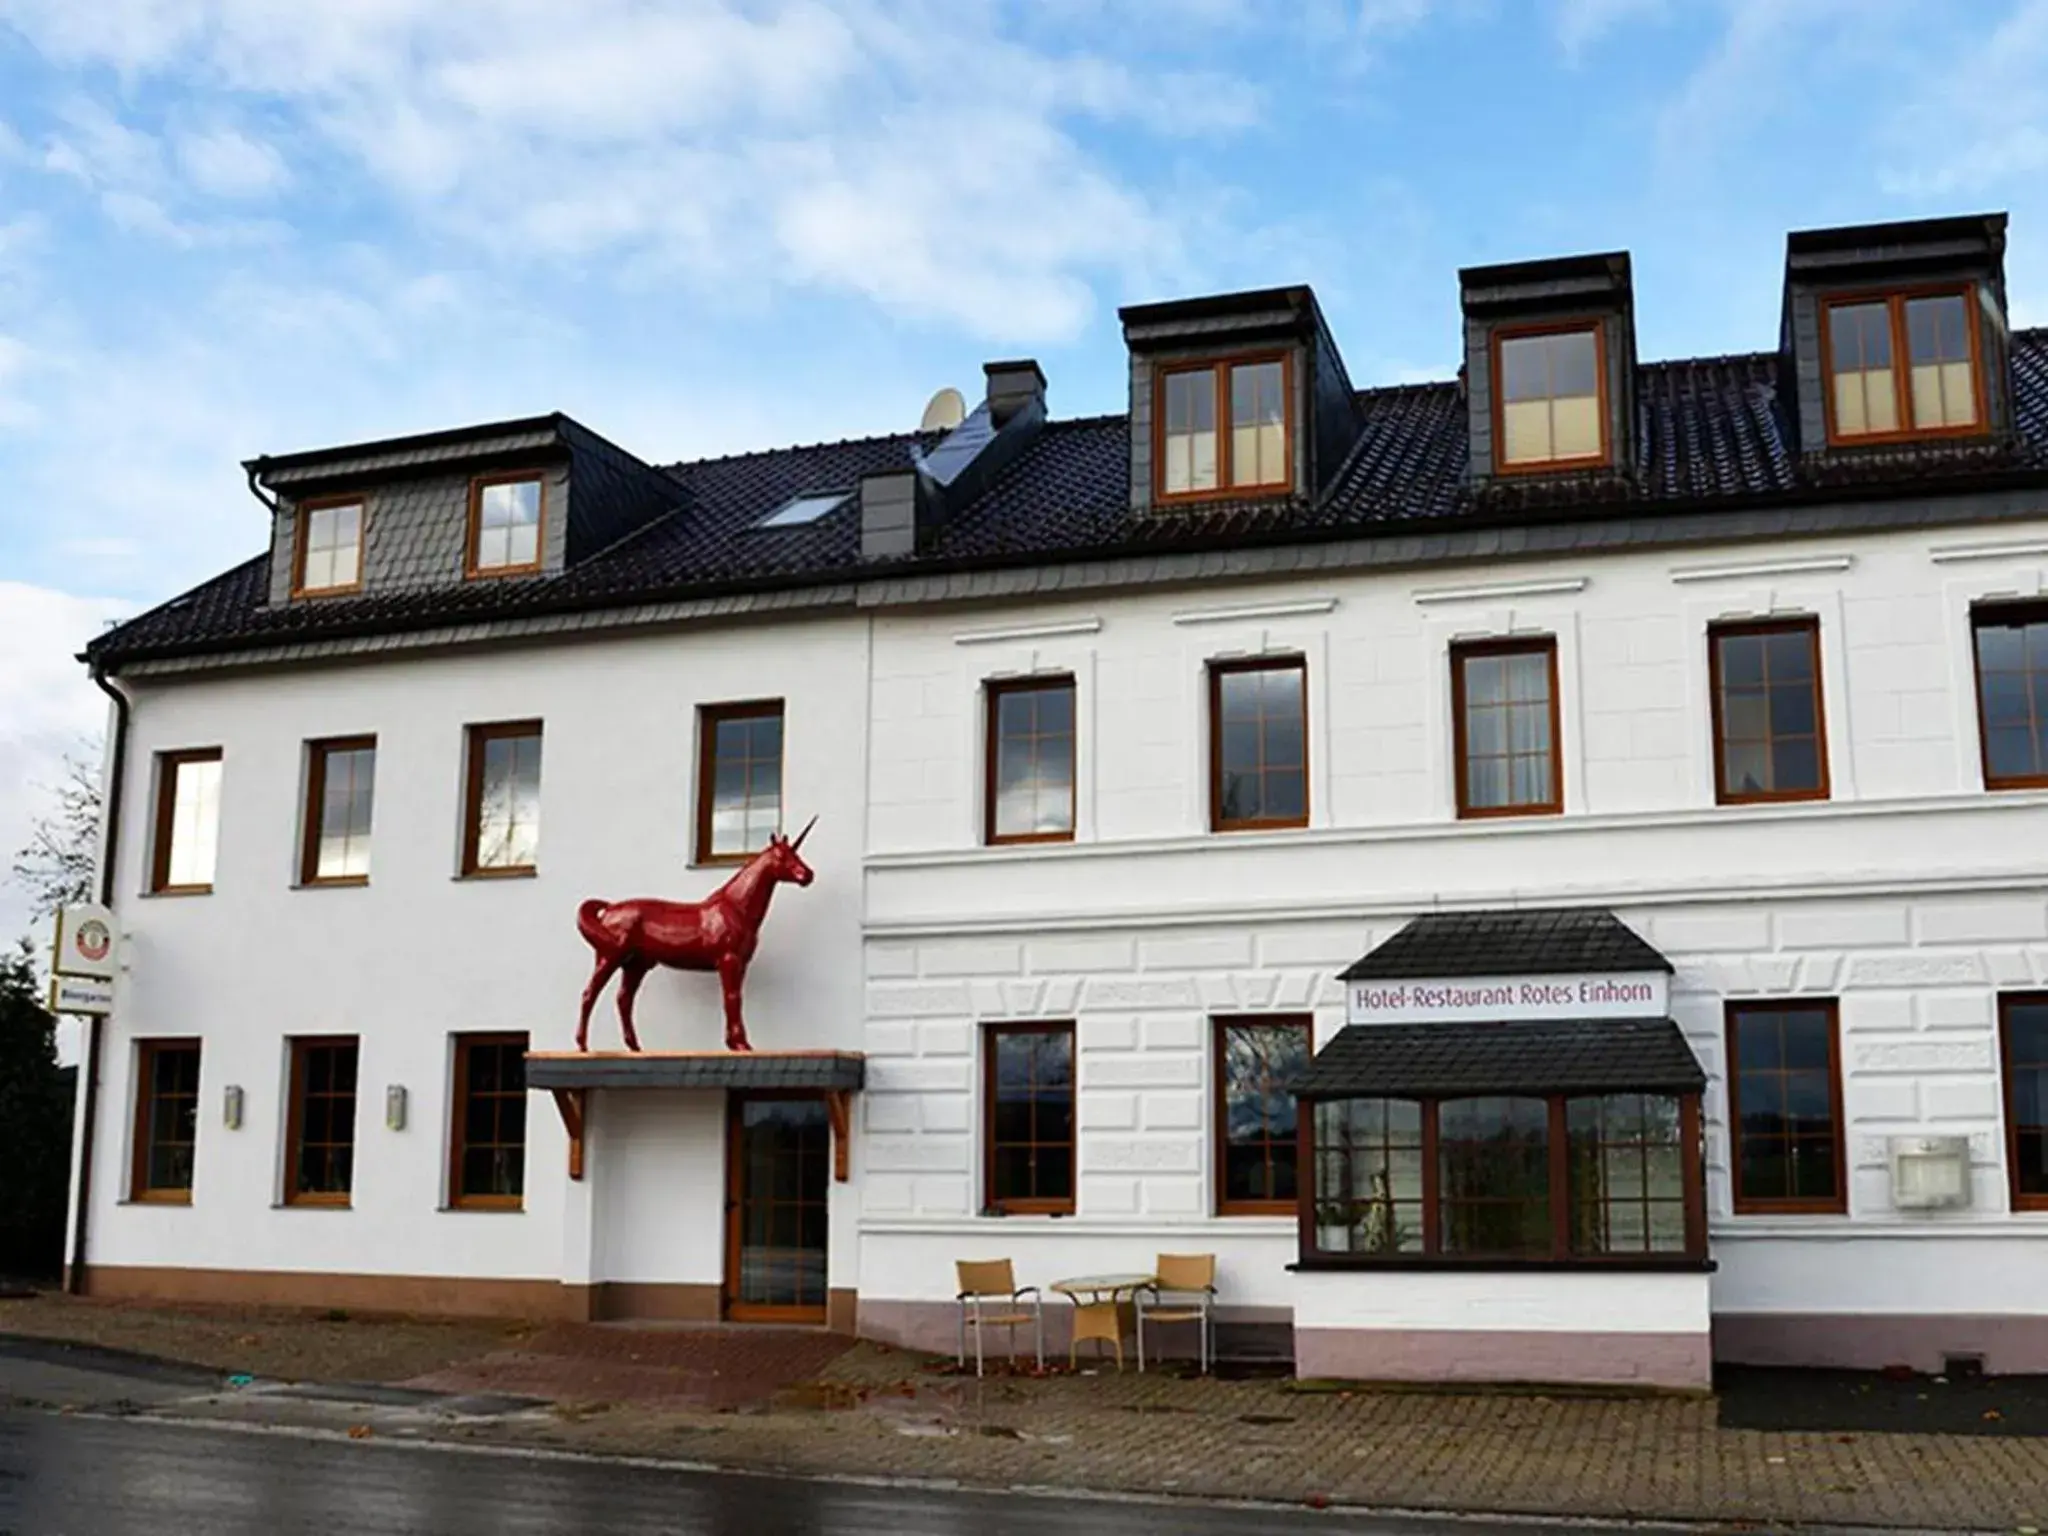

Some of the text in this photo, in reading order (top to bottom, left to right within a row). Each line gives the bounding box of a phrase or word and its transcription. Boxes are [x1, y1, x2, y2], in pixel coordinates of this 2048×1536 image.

[1356, 979, 1652, 1009] Hotel-Restaurant Rotes Einhorn
